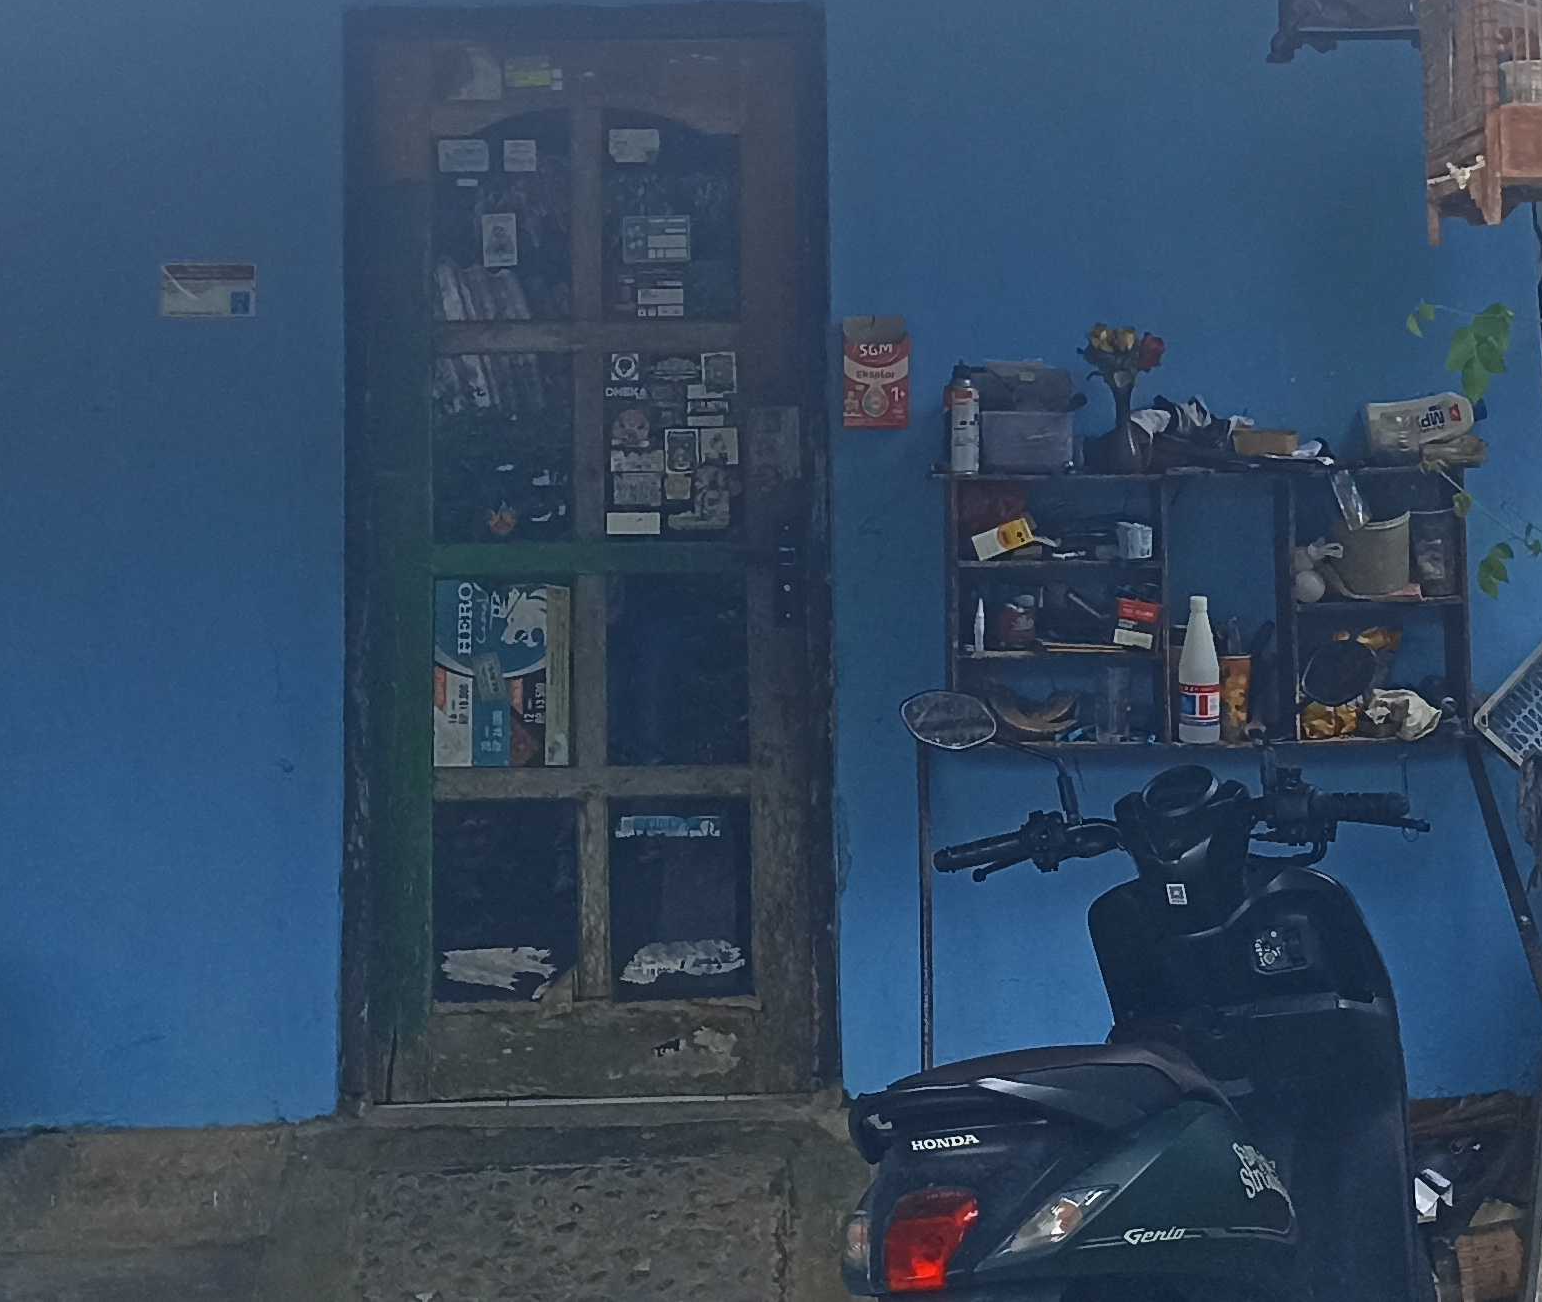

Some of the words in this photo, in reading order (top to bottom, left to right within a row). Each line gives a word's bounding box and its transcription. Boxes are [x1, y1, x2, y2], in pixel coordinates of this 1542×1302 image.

[859, 343, 893, 357] SGM
[457, 582, 473, 655] HERO
[911, 1134, 980, 1151] HONDA
[1123, 1226, 1186, 1245] Genio
